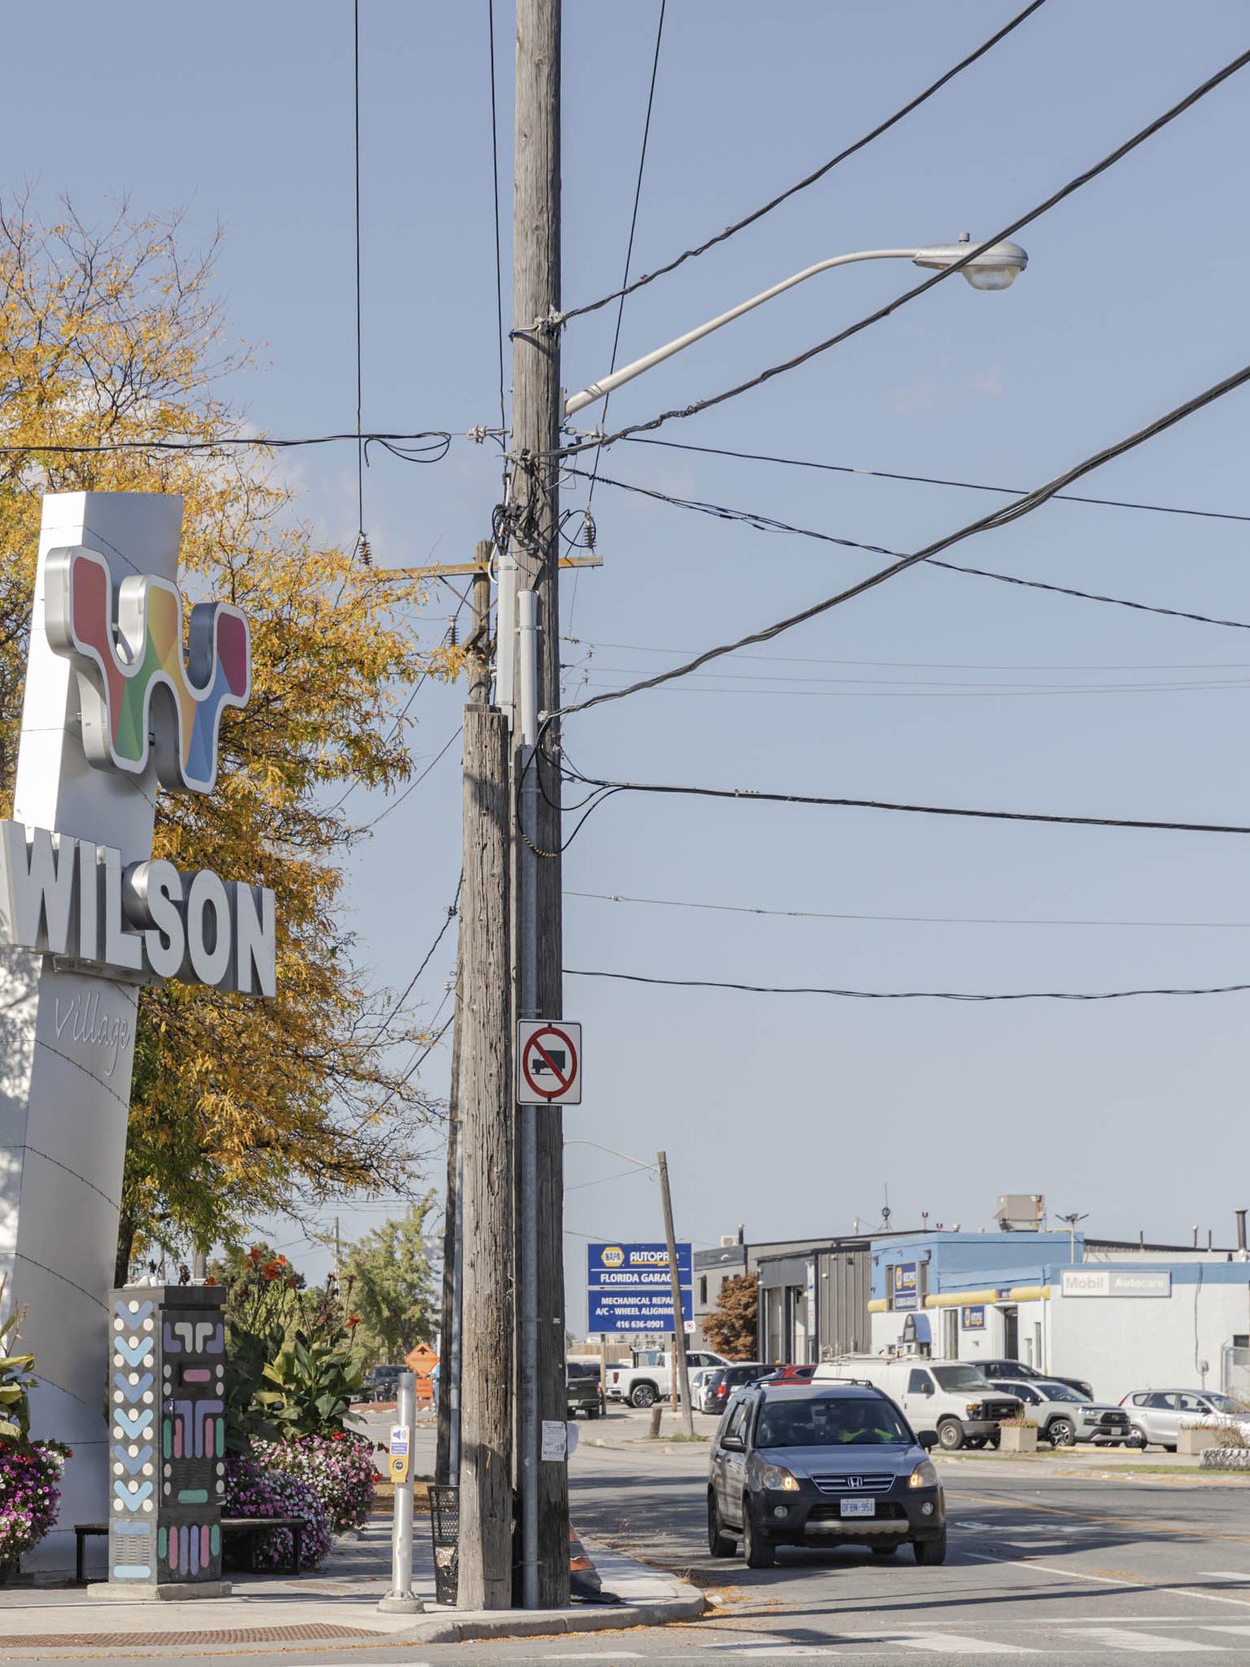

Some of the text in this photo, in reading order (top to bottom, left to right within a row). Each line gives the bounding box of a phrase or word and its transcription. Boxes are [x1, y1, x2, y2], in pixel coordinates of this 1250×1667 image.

[0, 819, 276, 998] WILSON
[55, 992, 131, 1077] Village
[630, 1251, 679, 1261] AUTOPR
[600, 1273, 639, 1283] FLORIDA
[601, 1297, 650, 1305] MECHANICAL
[595, 1307, 609, 1316] A/C
[615, 1307, 639, 1315] WHEEL
[616, 1320, 664, 1329] 416 636-0901
